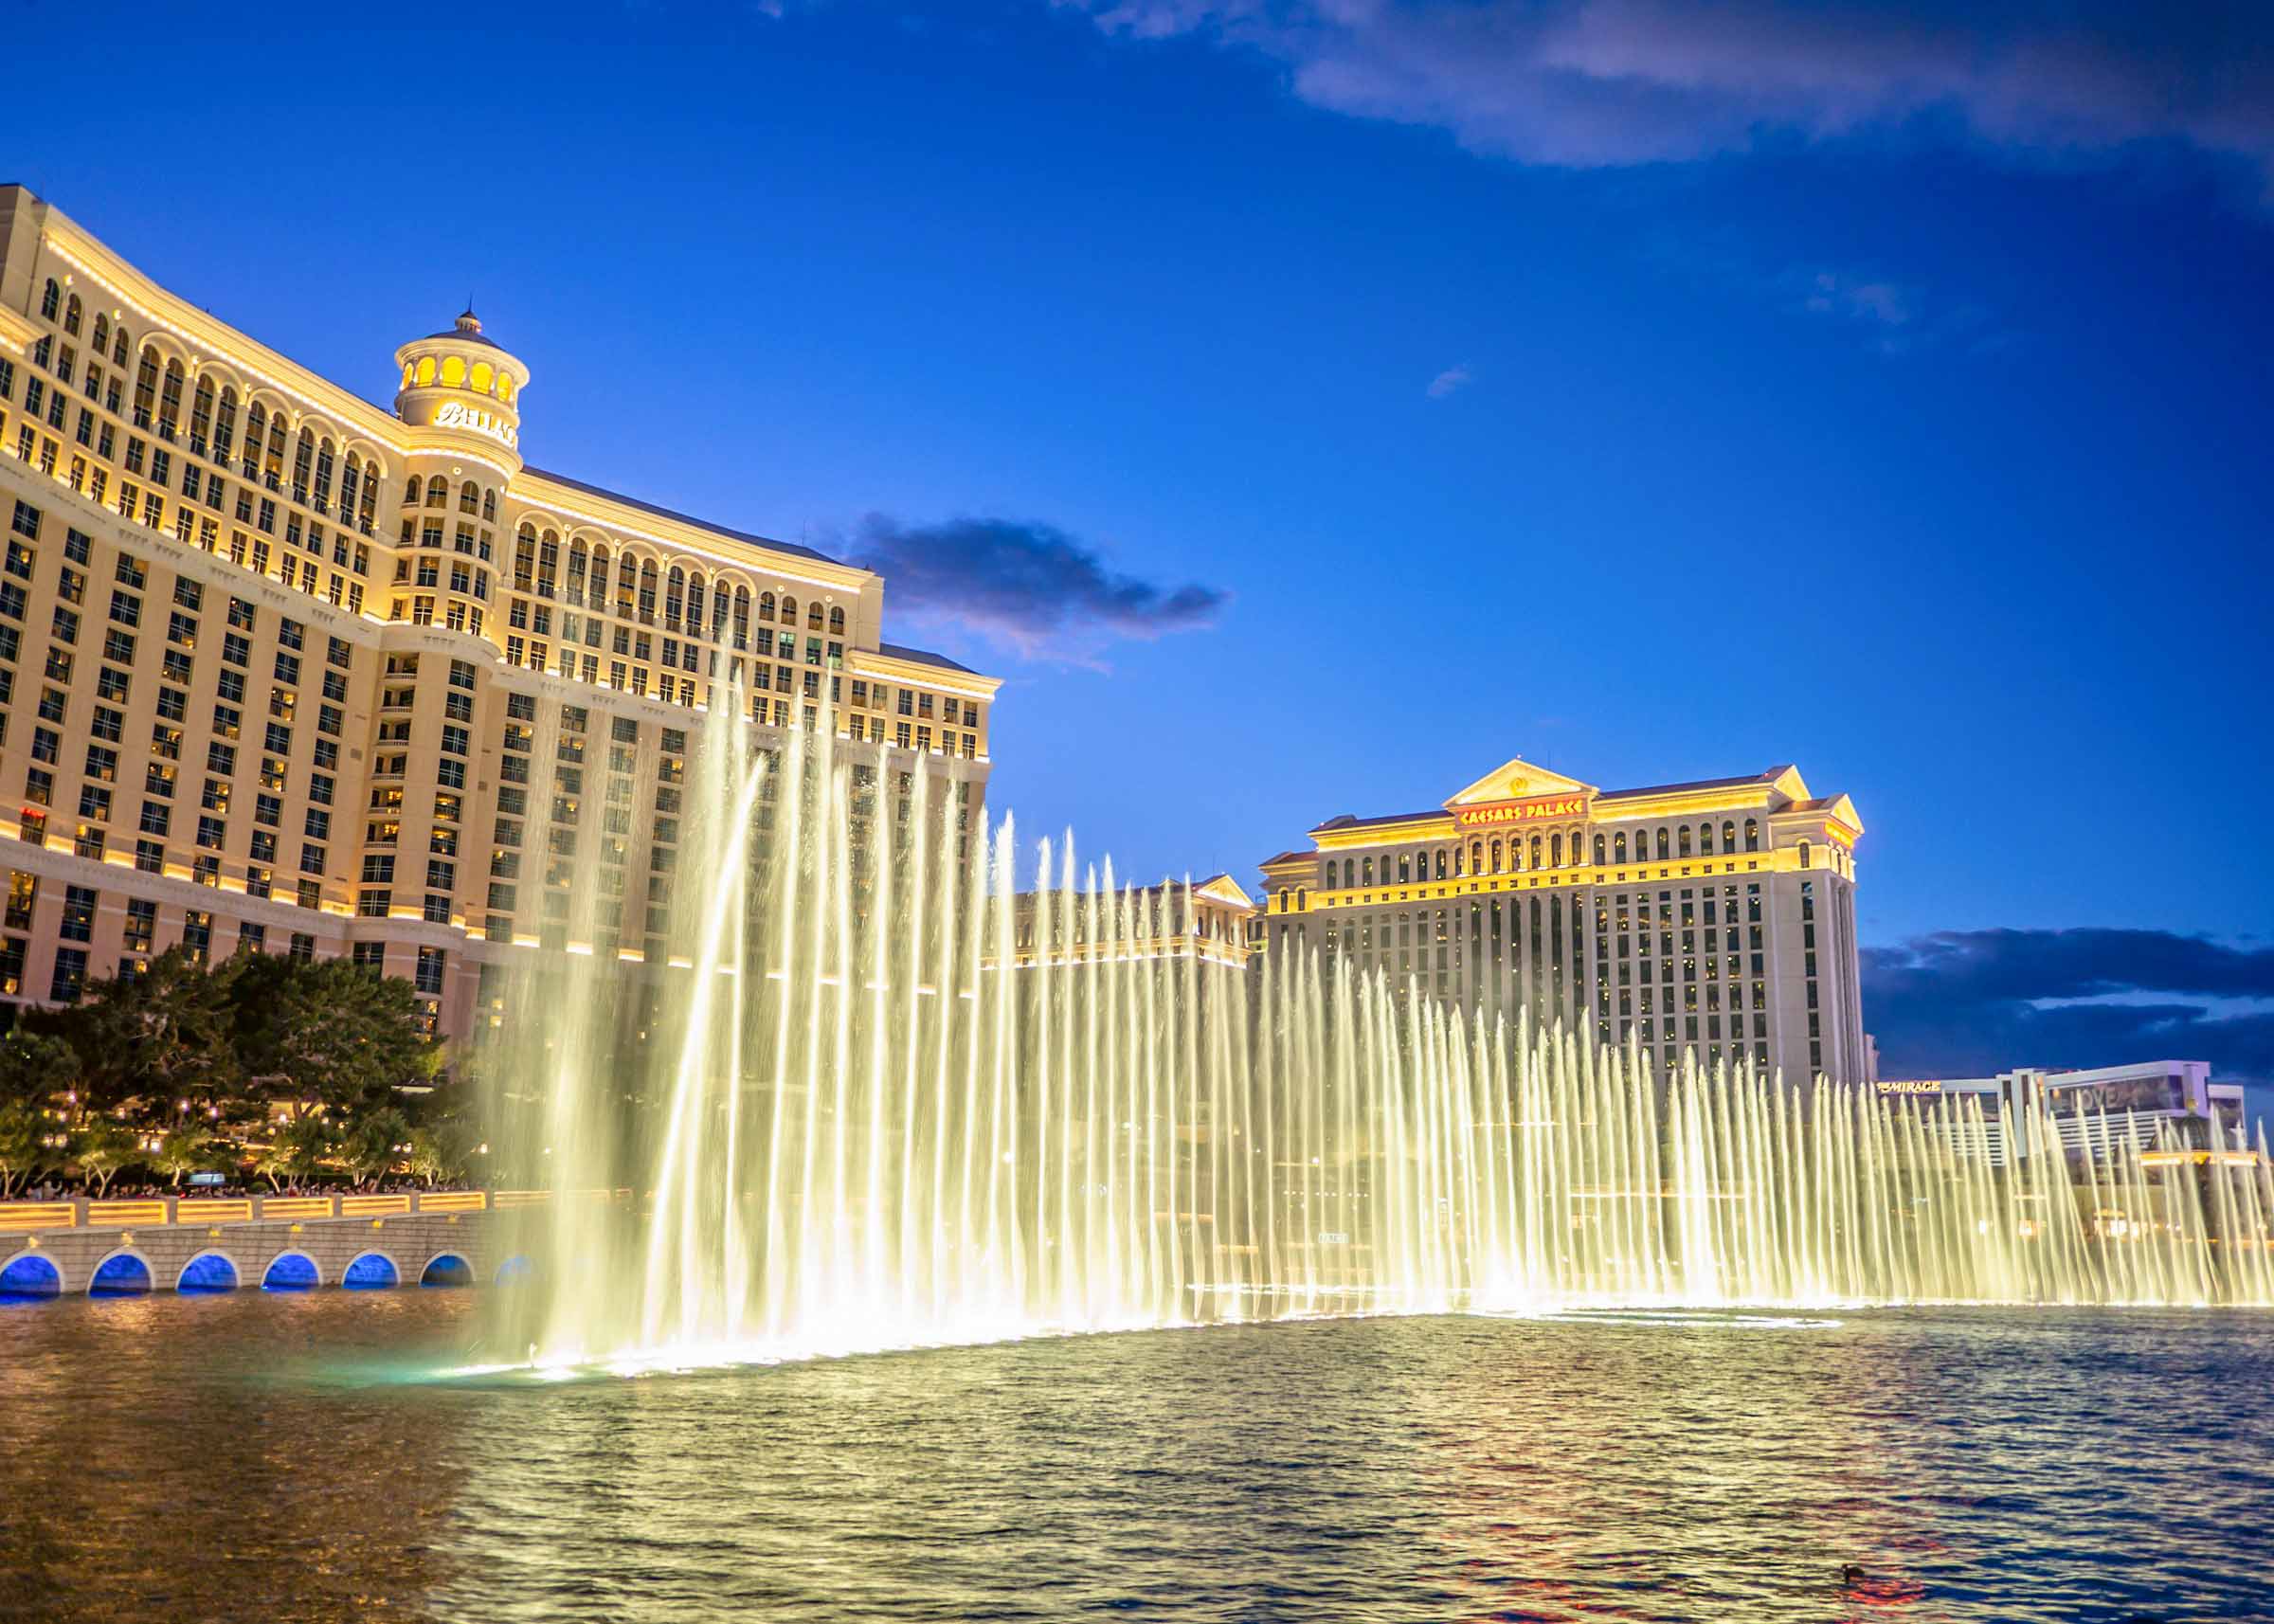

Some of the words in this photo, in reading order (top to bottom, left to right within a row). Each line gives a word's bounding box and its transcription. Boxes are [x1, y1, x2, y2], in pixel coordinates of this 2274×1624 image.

[1460, 807, 1522, 825] CAESARS
[1526, 800, 1582, 819] PALACE
[1890, 1080, 1940, 1093] MIRAGE
